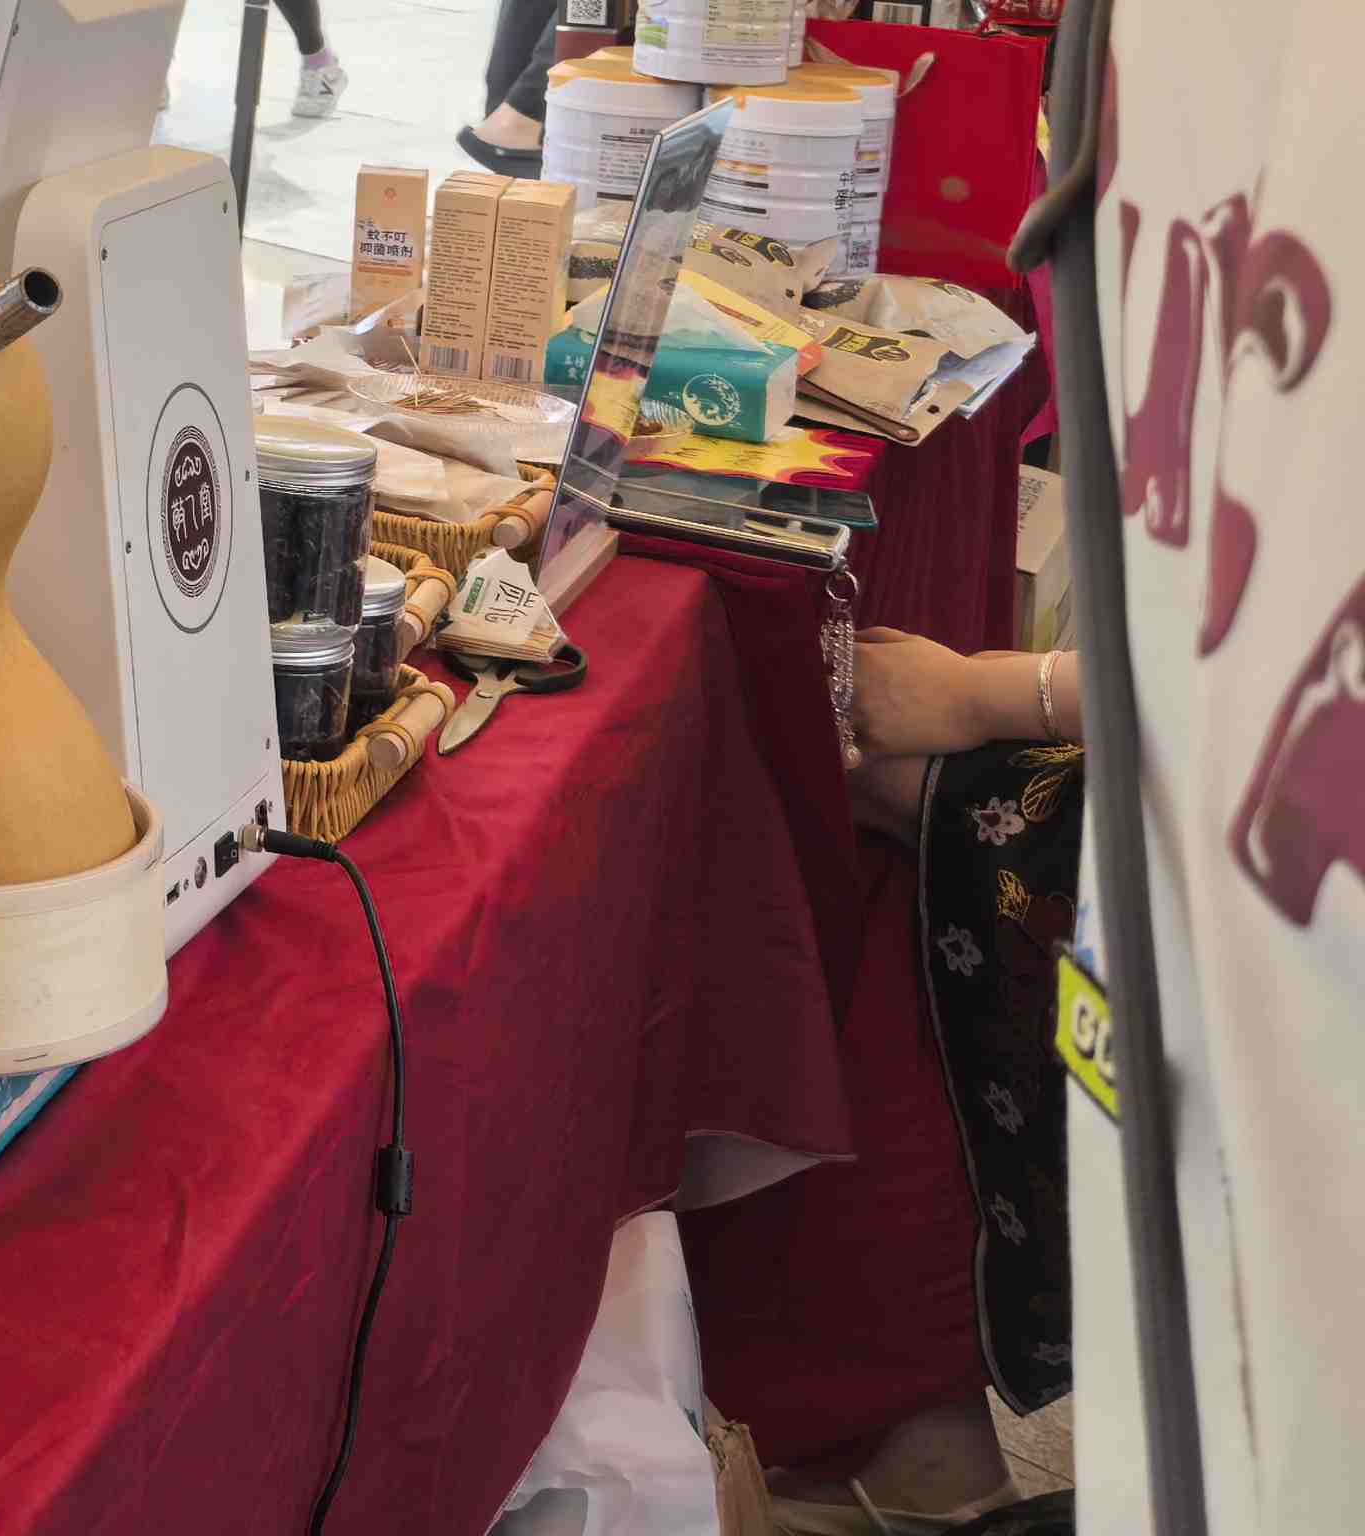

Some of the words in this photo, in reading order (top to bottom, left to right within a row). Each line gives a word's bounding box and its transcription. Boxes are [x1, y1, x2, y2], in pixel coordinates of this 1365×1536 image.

[366, 230, 409, 244] 蚊不叮
[359, 242, 414, 258] 抑菌喷剂
